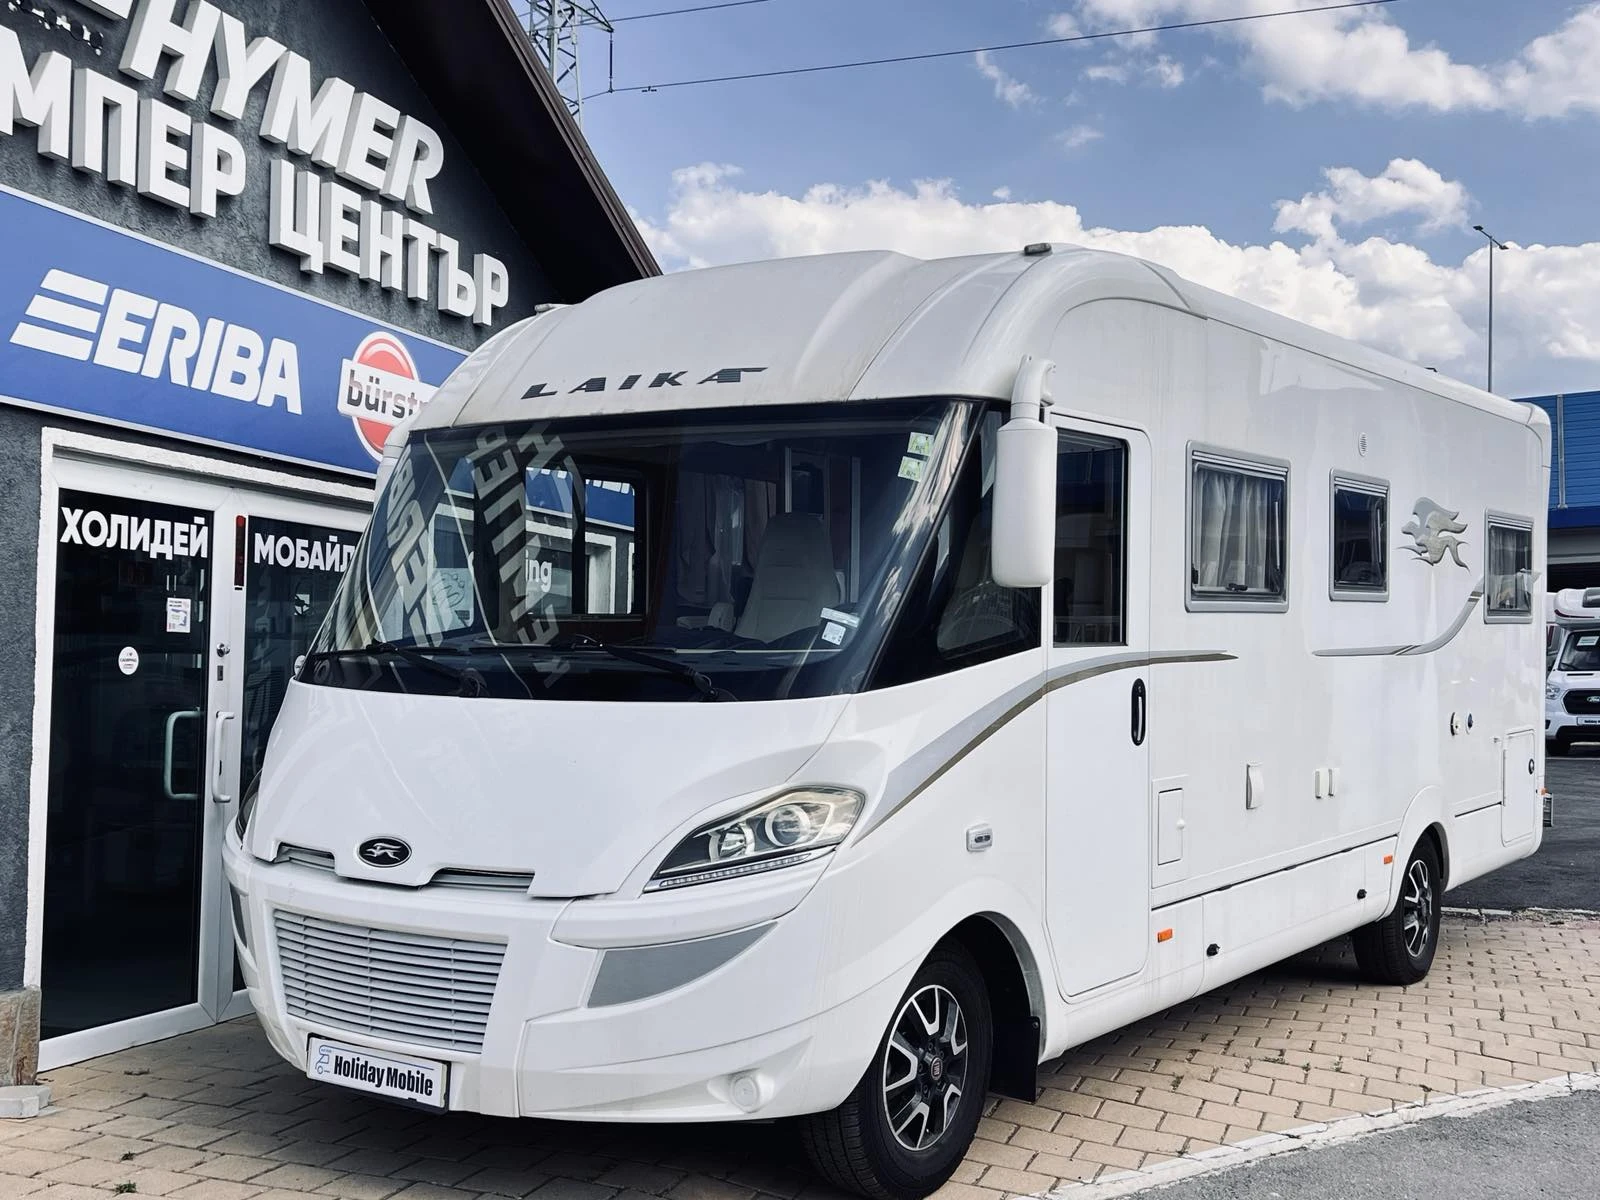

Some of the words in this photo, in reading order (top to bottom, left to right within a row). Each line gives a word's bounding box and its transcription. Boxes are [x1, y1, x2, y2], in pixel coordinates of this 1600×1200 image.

[119, 0, 444, 215] HYMER
[268, 158, 509, 326] ЦЕНТЪР
[93, 288, 303, 416] ERIBA
[347, 368, 428, 419] bürst
[520, 366, 769, 400] LAIKA
[59, 506, 209, 561] ХОЛИДЕЙ
[333, 1054, 386, 1088] Holiday
[386, 1066, 434, 1097] Mobile
